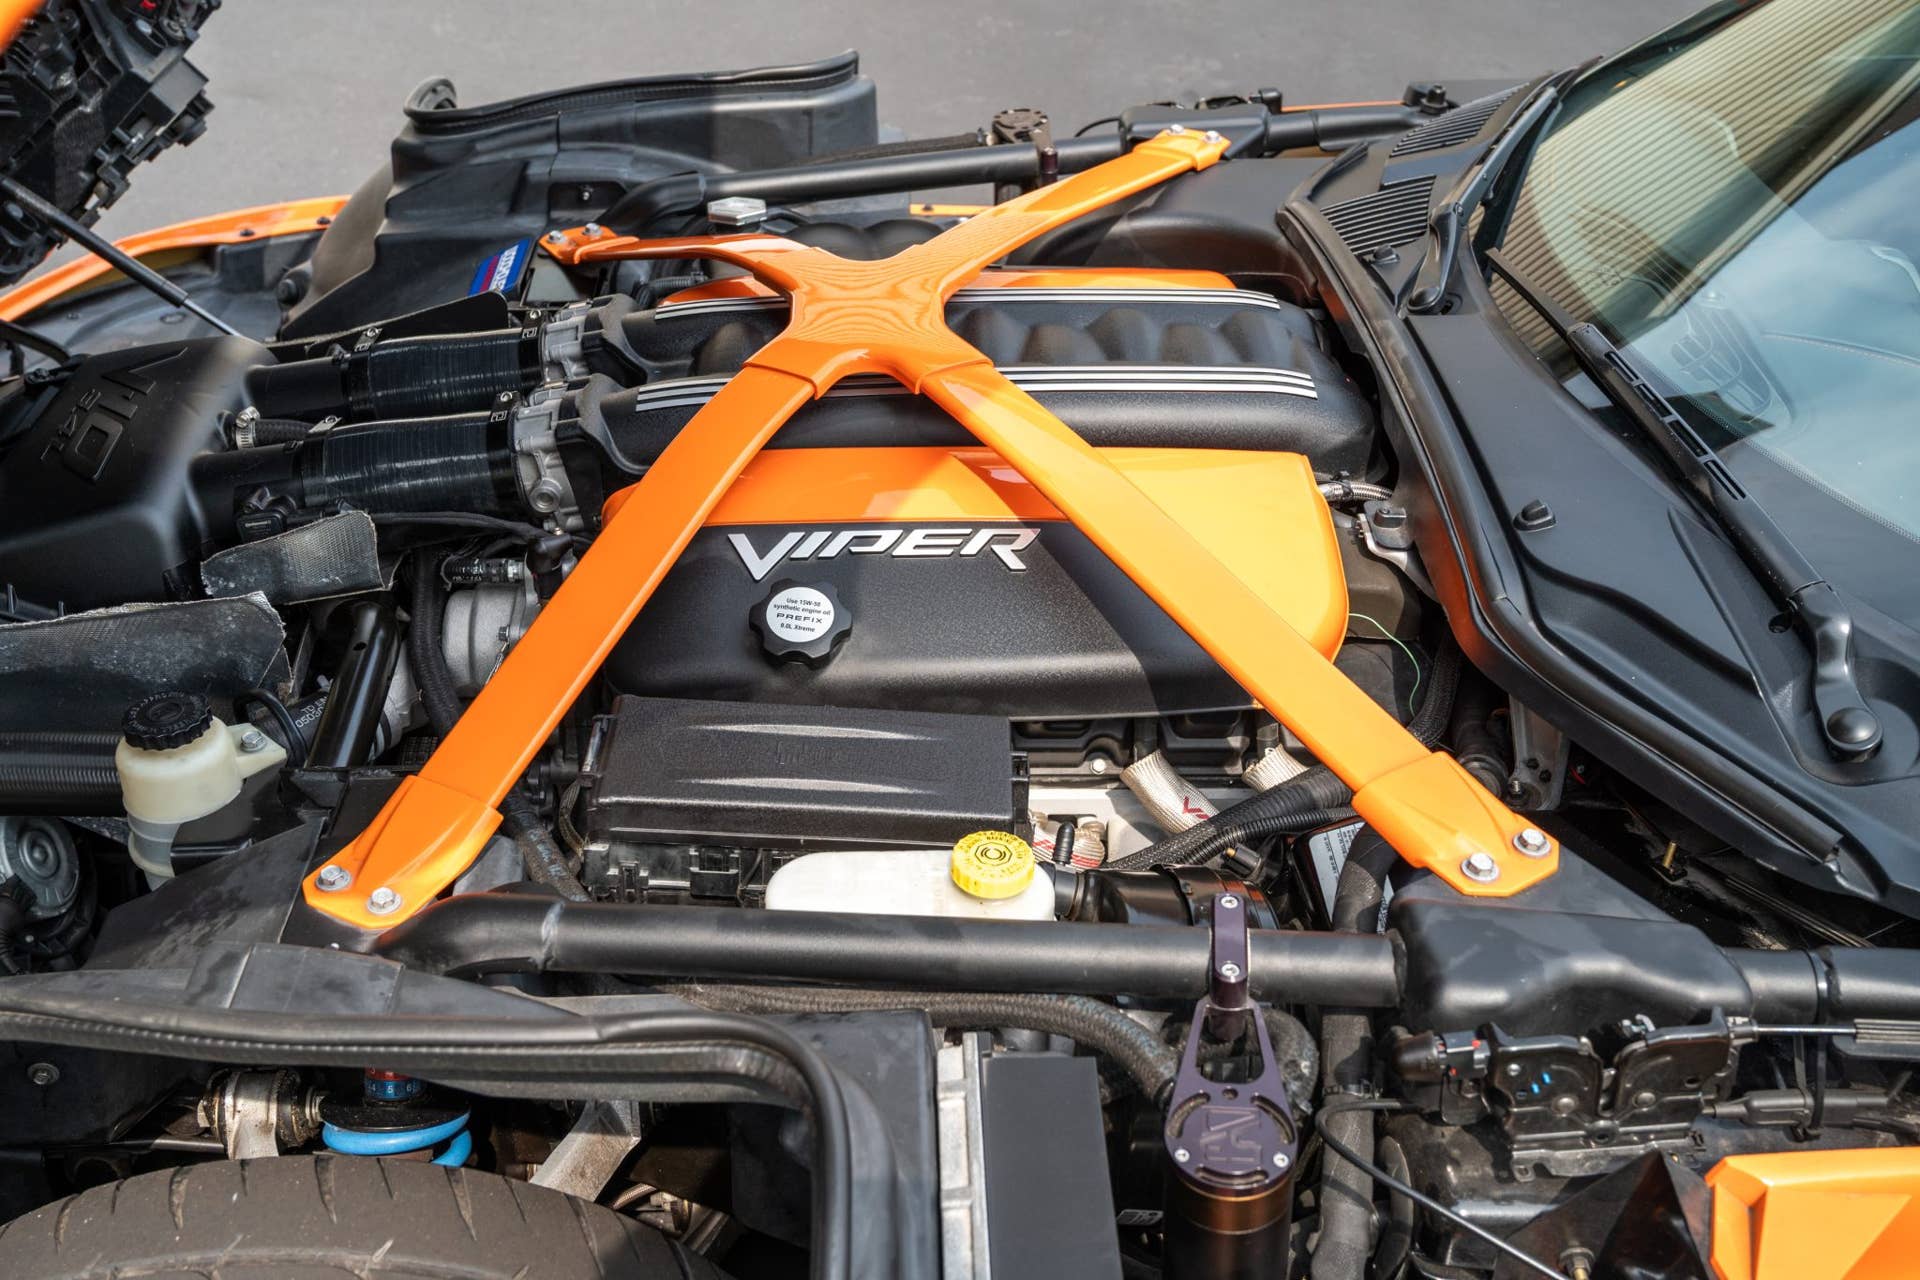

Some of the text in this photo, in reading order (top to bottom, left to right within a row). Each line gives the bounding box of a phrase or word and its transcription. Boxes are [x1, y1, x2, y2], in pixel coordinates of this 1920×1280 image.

[728, 528, 1041, 581] VIPER
[774, 603, 800, 612] synthetic
[802, 607, 822, 615] engine
[776, 612, 822, 624] PREFIX
[793, 624, 816, 632] Xtreme
